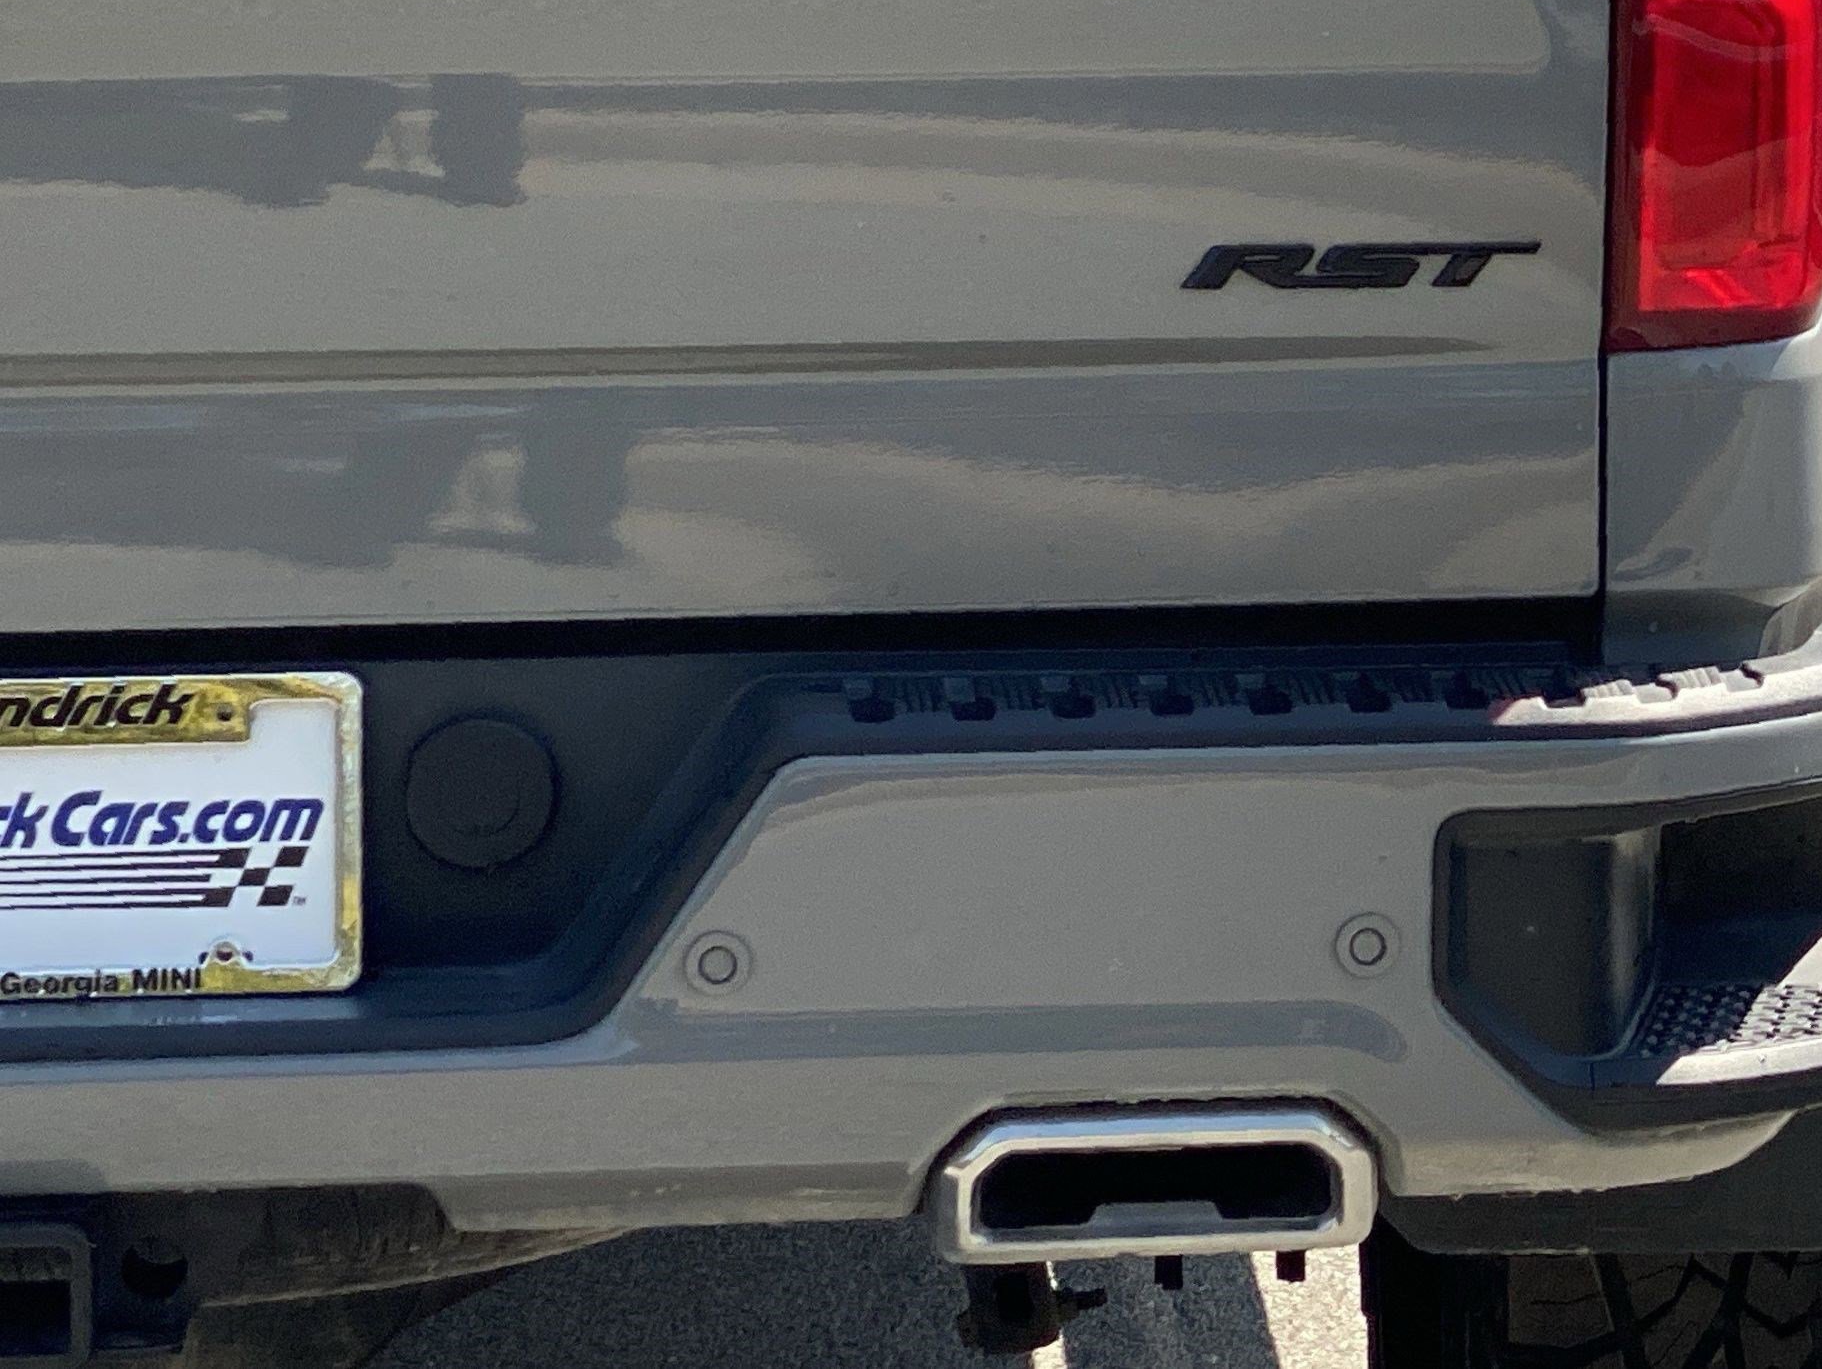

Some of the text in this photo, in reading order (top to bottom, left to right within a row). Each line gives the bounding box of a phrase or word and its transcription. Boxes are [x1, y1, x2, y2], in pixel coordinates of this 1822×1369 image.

[1180, 241, 1541, 290] RST
[0, 966, 201, 995] Georgia MINI
